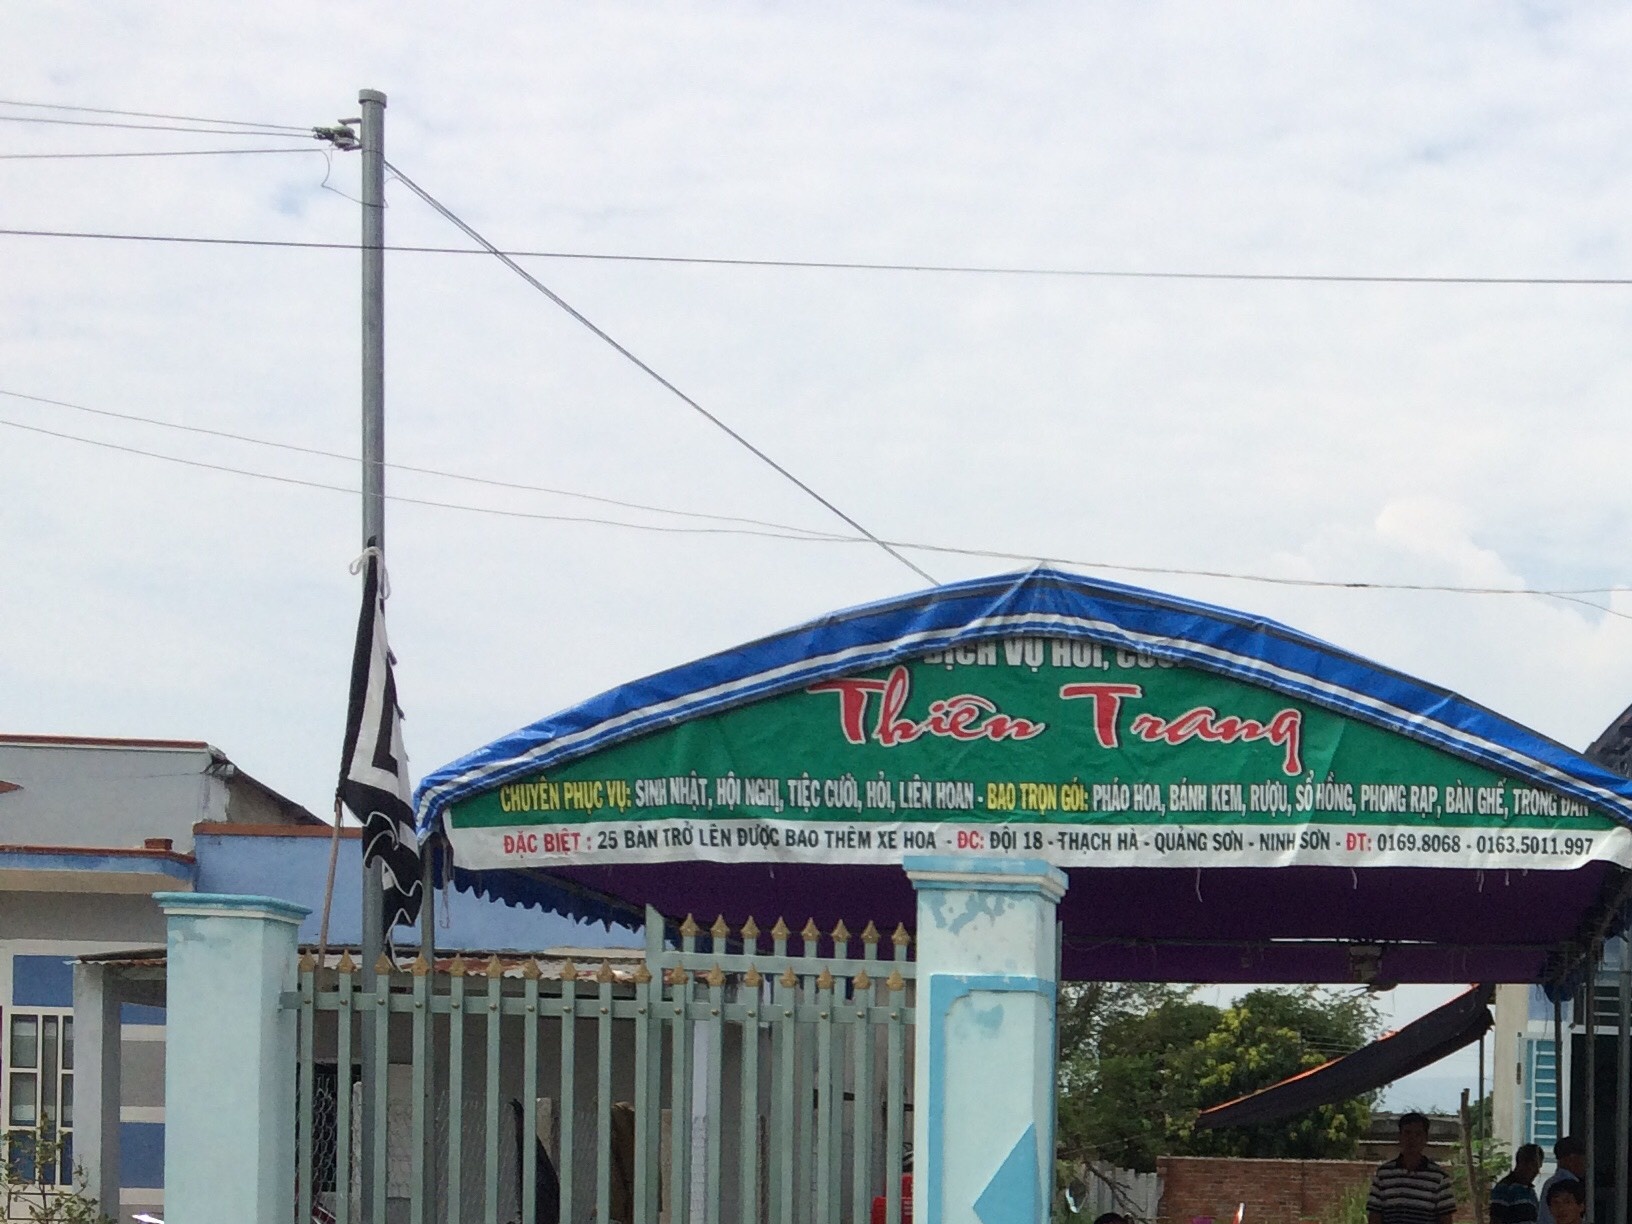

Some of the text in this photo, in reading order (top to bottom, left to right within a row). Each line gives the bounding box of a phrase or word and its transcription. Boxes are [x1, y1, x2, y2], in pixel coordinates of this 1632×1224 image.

[806, 665, 1303, 776] Thiên Trang
[501, 775, 560, 812] CHUYÊN
[563, 780, 603, 815] PHỤC
[606, 780, 631, 814] VỤ:
[635, 778, 667, 807] SINH
[670, 770, 713, 811] NHẬT,
[716, 771, 741, 811] HỘI
[744, 778, 784, 813] NGHỊ,
[787, 772, 820, 813] TIỆC
[866, 770, 896, 814] HỎI,
[900, 774, 932, 809] LIÊN
[935, 781, 974, 810] HOAN
[986, 782, 1016, 811] BAO
[1019, 783, 1057, 815] TRỌN
[1060, 777, 1089, 812] GÓI:
[1092, 777, 1130, 812] PHÁO
[1133, 784, 1166, 816] HOA,
[1169, 777, 1207, 812] BÁNH
[1211, 784, 1247, 817] KEM,
[1250, 780, 1292, 817] RƯỢU,
[1295, 769, 1314, 811] SỔ
[1315, 771, 1356, 816] HỒNG,
[1361, 784, 1406, 812] PHONG
[1410, 785, 1441, 818] RẠP,
[1445, 779, 1473, 813] BÀN
[1477, 778, 1508, 820] GHẾ,
[503, 830, 538, 858] ĐẶC
[544, 828, 580, 855] BIỆT
[597, 830, 618, 849] 25
[624, 824, 658, 849] BÀN
[663, 820, 694, 847] TRỞ
[700, 823, 732, 847] LÊN
[737, 826, 780, 850] ĐƯỢC
[785, 829, 819, 848] BAO
[824, 825, 872, 849] THÊM
[877, 830, 898, 849] XE
[903, 830, 937, 850] HOA
[957, 830, 985, 850] ĐC:
[990, 826, 1017, 854] ĐỘI
[1023, 831, 1043, 850] 18
[1057, 831, 1112, 855] THẠCH
[1117, 827, 1139, 851] HÀ
[1154, 826, 1208, 855] QUẢNG
[1212, 830, 1244, 851] SƠN
[1259, 832, 1296, 852] NINH
[1300, 828, 1331, 850] SƠN
[1346, 832, 1372, 851] ĐT:
[1377, 833, 1461, 853] 0169.8068
[1476, 835, 1594, 856] 0163.5011.997
